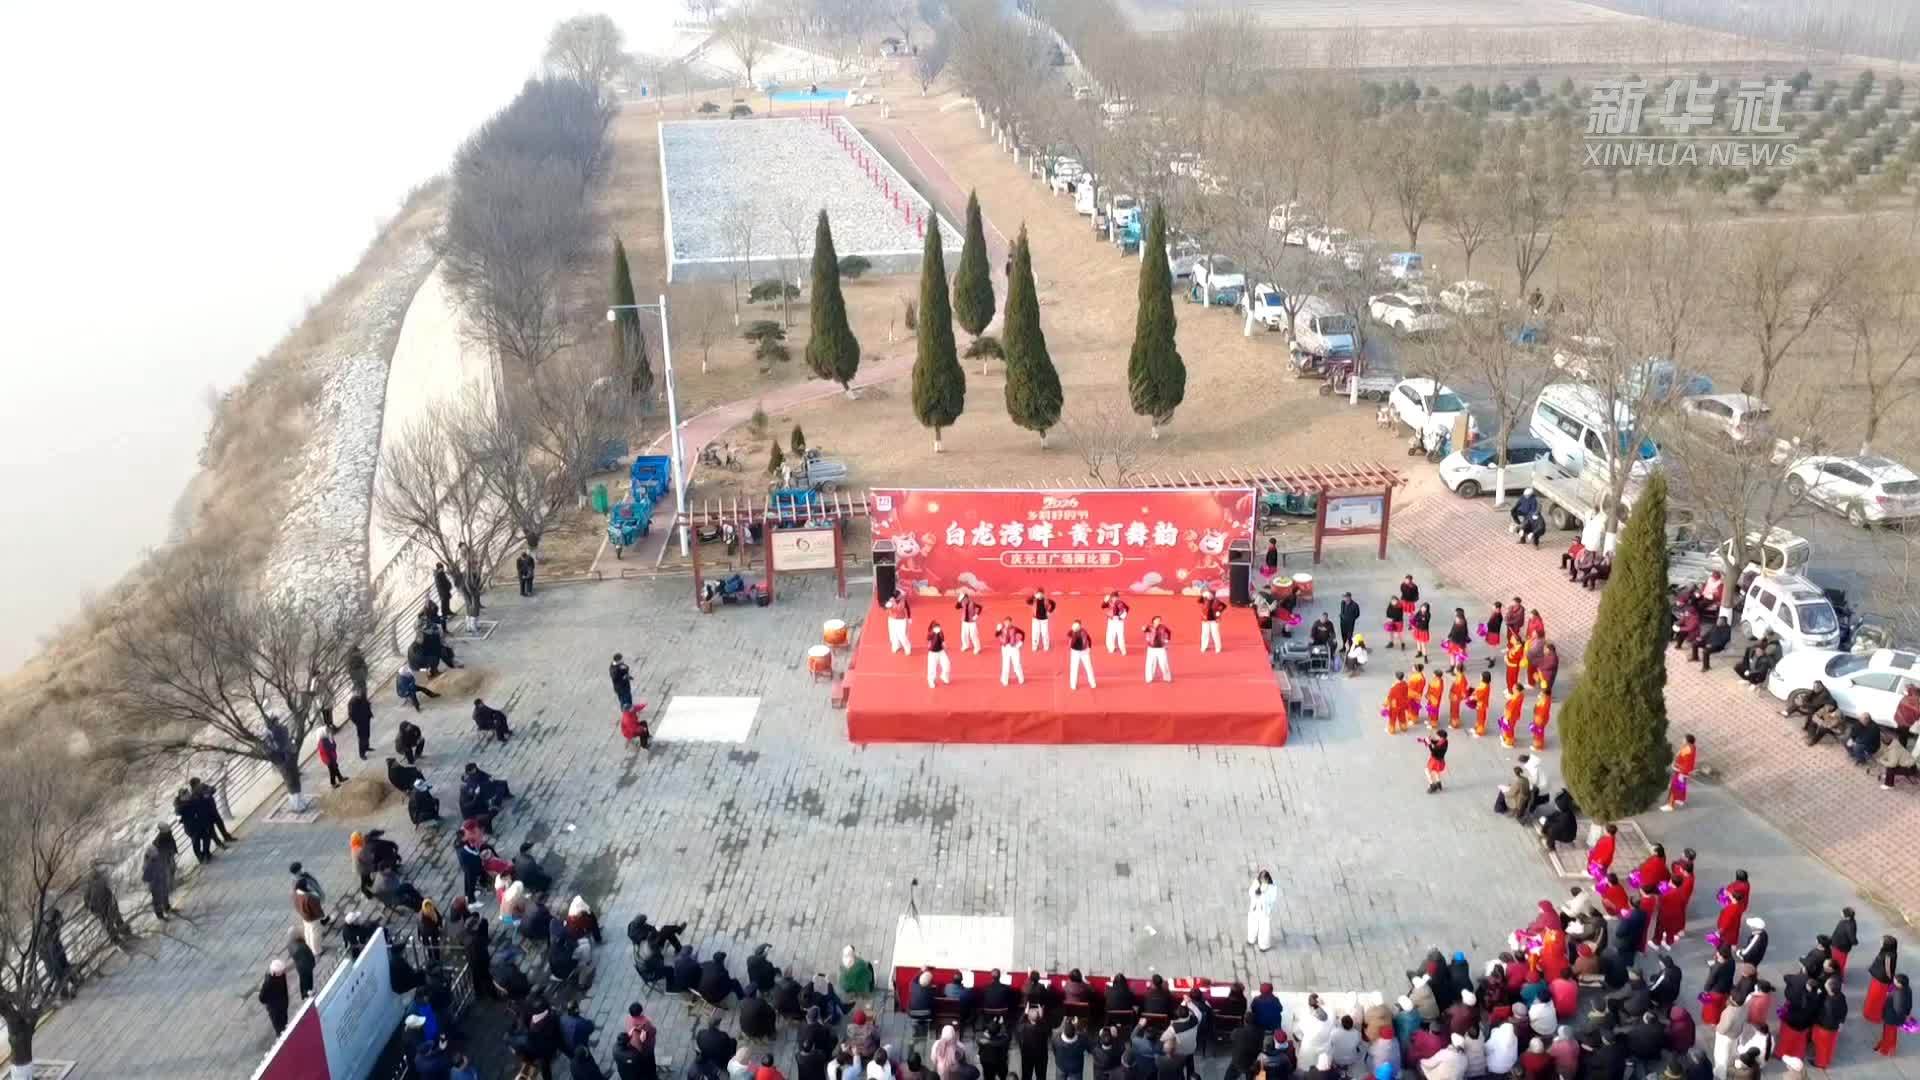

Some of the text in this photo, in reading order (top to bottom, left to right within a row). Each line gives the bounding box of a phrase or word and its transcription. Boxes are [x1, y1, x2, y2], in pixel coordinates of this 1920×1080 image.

[945, 521, 1179, 547] 白龙湾畔·黄河舞韵
